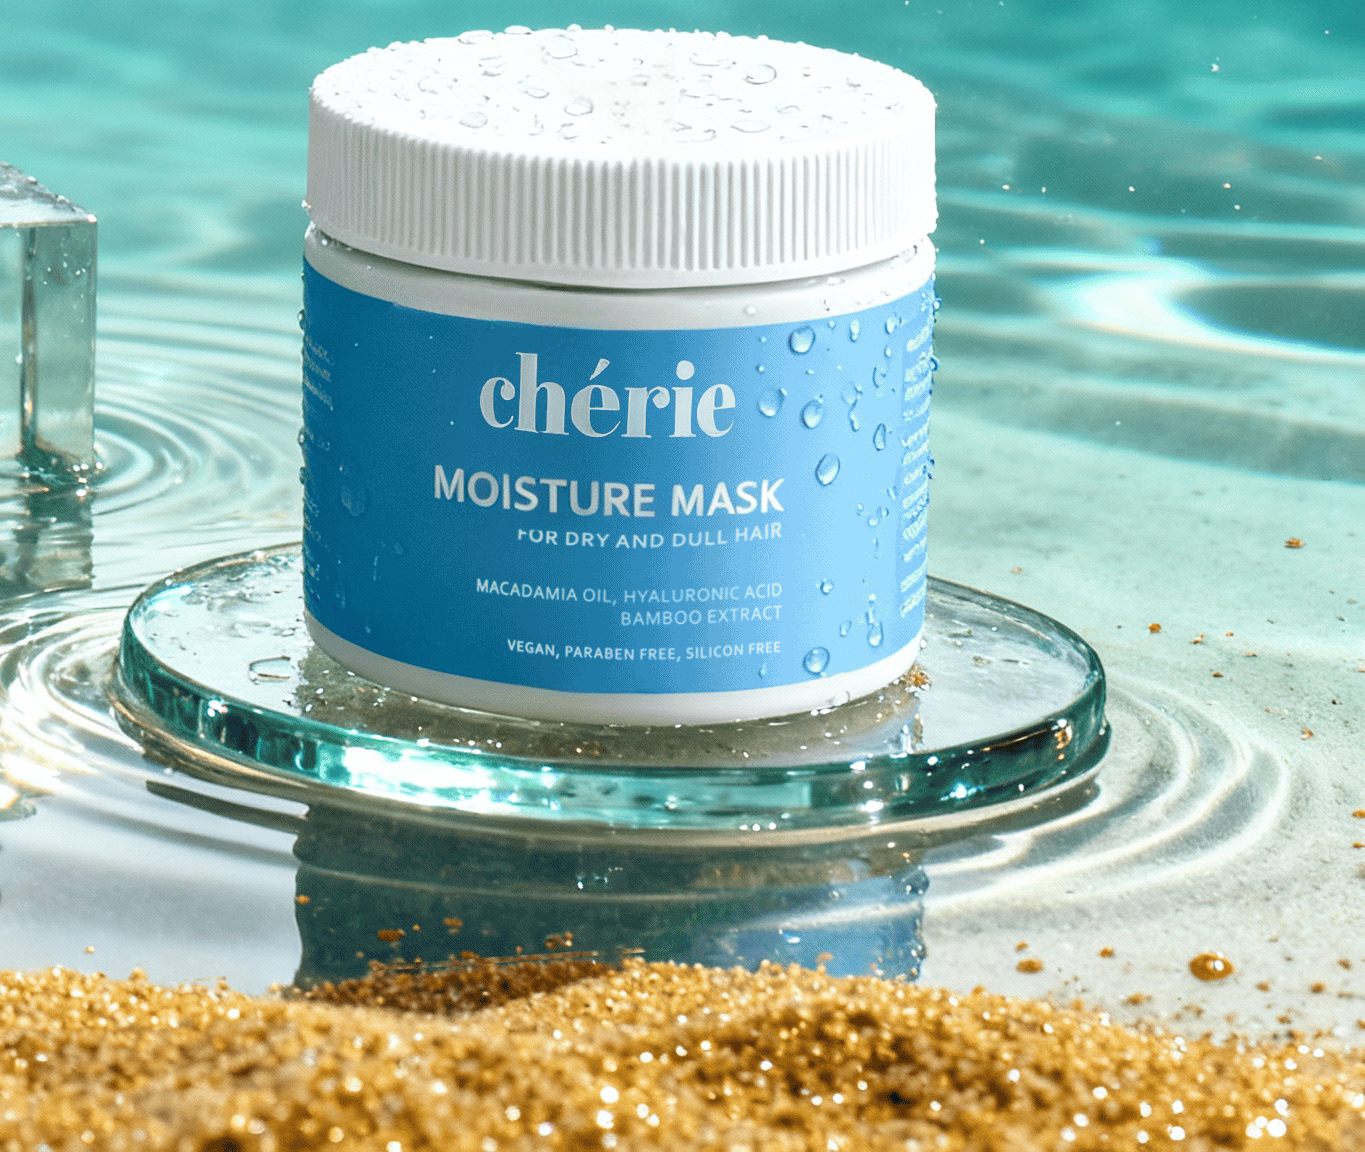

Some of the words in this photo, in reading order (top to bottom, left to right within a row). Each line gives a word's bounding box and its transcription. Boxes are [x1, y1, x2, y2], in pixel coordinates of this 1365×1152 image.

[479, 352, 736, 438] chérie
[434, 464, 656, 517] MOISTURE
[671, 478, 785, 517] MASK
[565, 531, 610, 547] DRY
[616, 534, 664, 548] AND
[672, 530, 728, 547] DULL
[735, 522, 782, 542] HAIR
[476, 578, 577, 601] MACADAMIA
[582, 588, 616, 606] OIL,
[624, 586, 740, 603] HYALURONIC
[744, 582, 783, 599] ACID
[621, 610, 702, 626] BAMBOO
[707, 605, 783, 623] EXTRACT
[507, 639, 560, 660] VEGAN,
[565, 645, 635, 660] PARABEN
[640, 648, 681, 662] FREE,
[686, 645, 744, 659] SILICON
[749, 641, 781, 655] FREE
